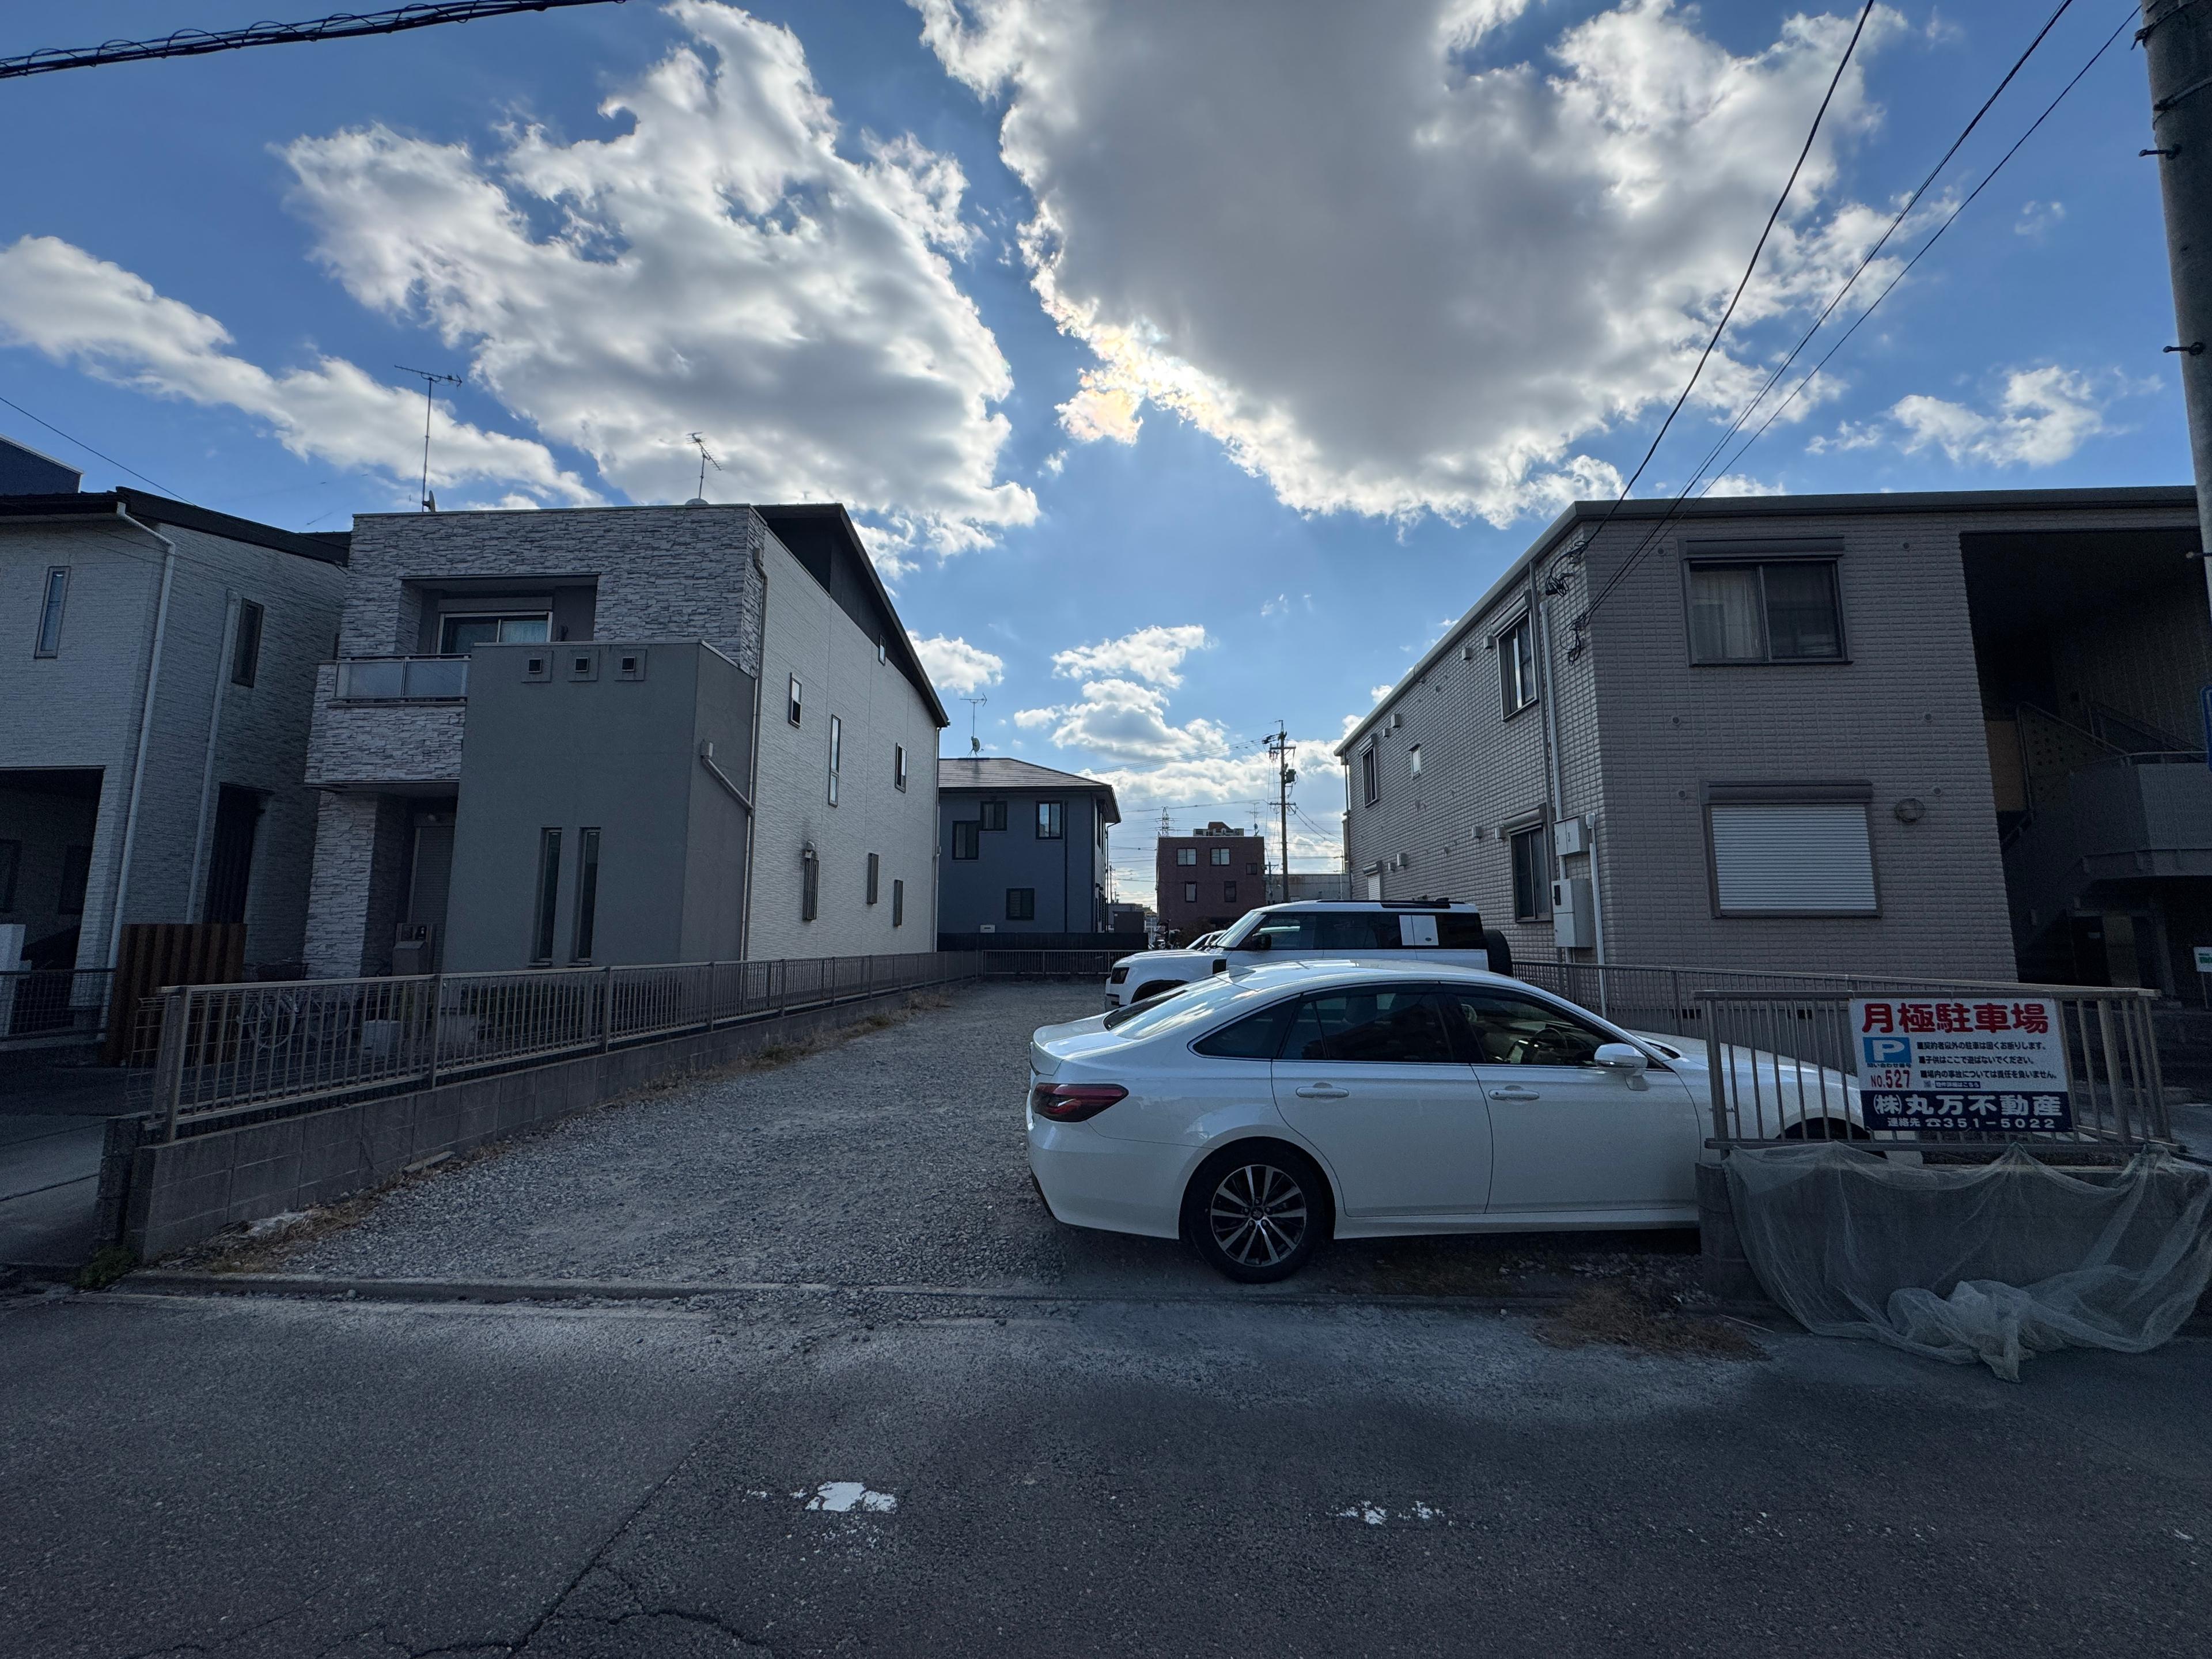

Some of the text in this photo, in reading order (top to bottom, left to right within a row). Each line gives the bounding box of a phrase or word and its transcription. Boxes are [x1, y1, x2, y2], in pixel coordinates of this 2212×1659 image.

[1862, 1002, 2049, 1033] 月極駐車場
[1872, 1039, 1905, 1062] P
[1887, 1117, 2055, 1128] 連絡先 351-5022
